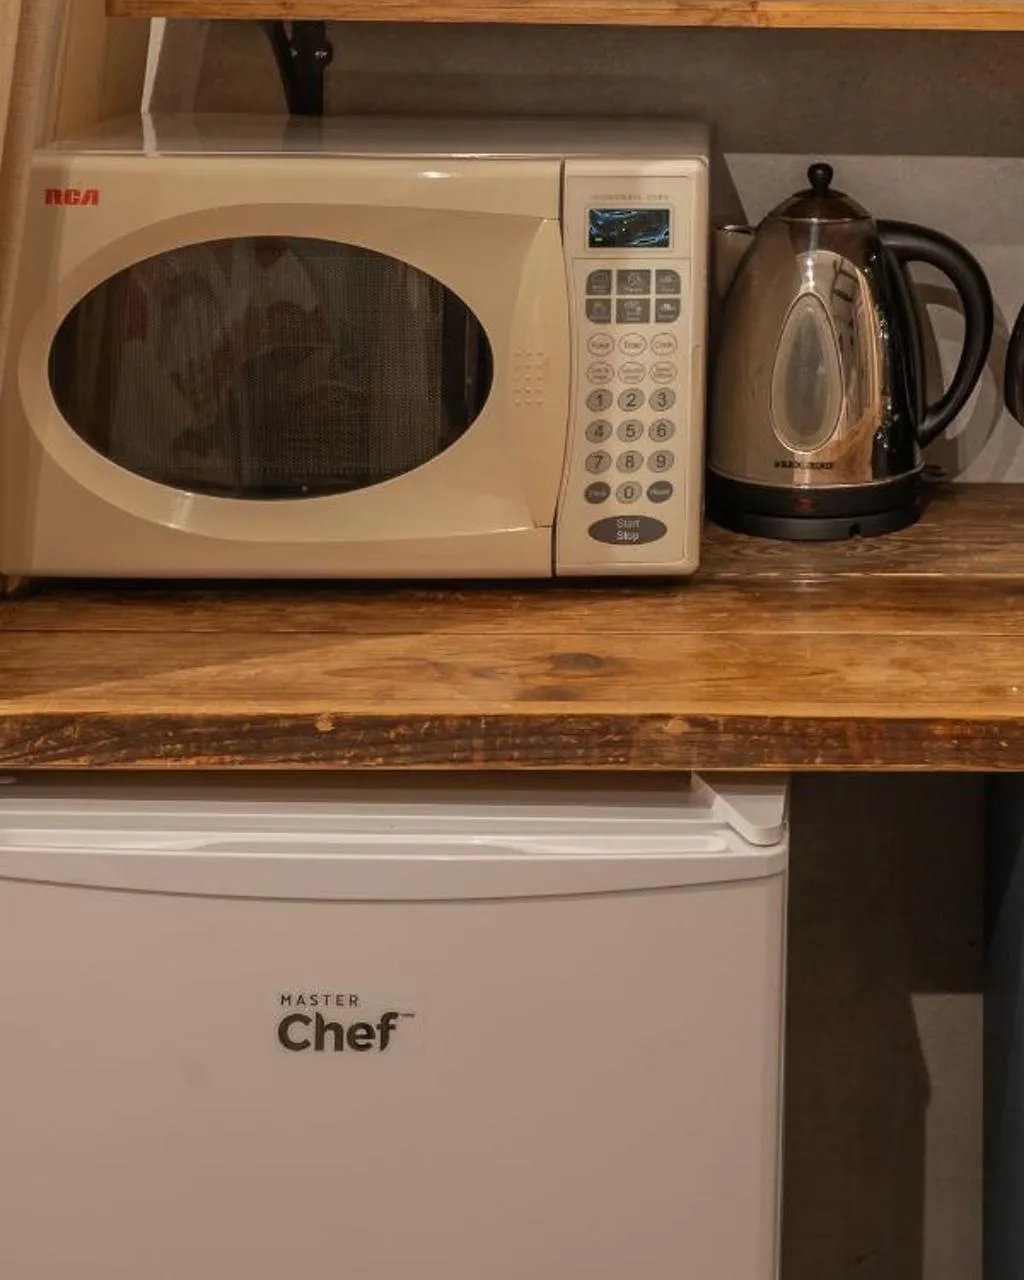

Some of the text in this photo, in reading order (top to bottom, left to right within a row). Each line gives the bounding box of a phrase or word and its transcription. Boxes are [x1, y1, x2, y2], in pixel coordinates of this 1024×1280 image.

[45, 188, 99, 206] RCA
[597, 393, 603, 406] 1
[626, 392, 637, 408] 2
[657, 392, 667, 408] 3
[594, 424, 604, 437] 4
[625, 423, 636, 438] 5
[656, 422, 667, 438] 6
[593, 455, 604, 469] 7
[625, 455, 635, 469] 8
[656, 454, 667, 469] 9
[624, 485, 634, 499] 0
[616, 530, 641, 542] Stop
[280, 994, 360, 1007] MASTER
[277, 1011, 399, 1052] Chef
